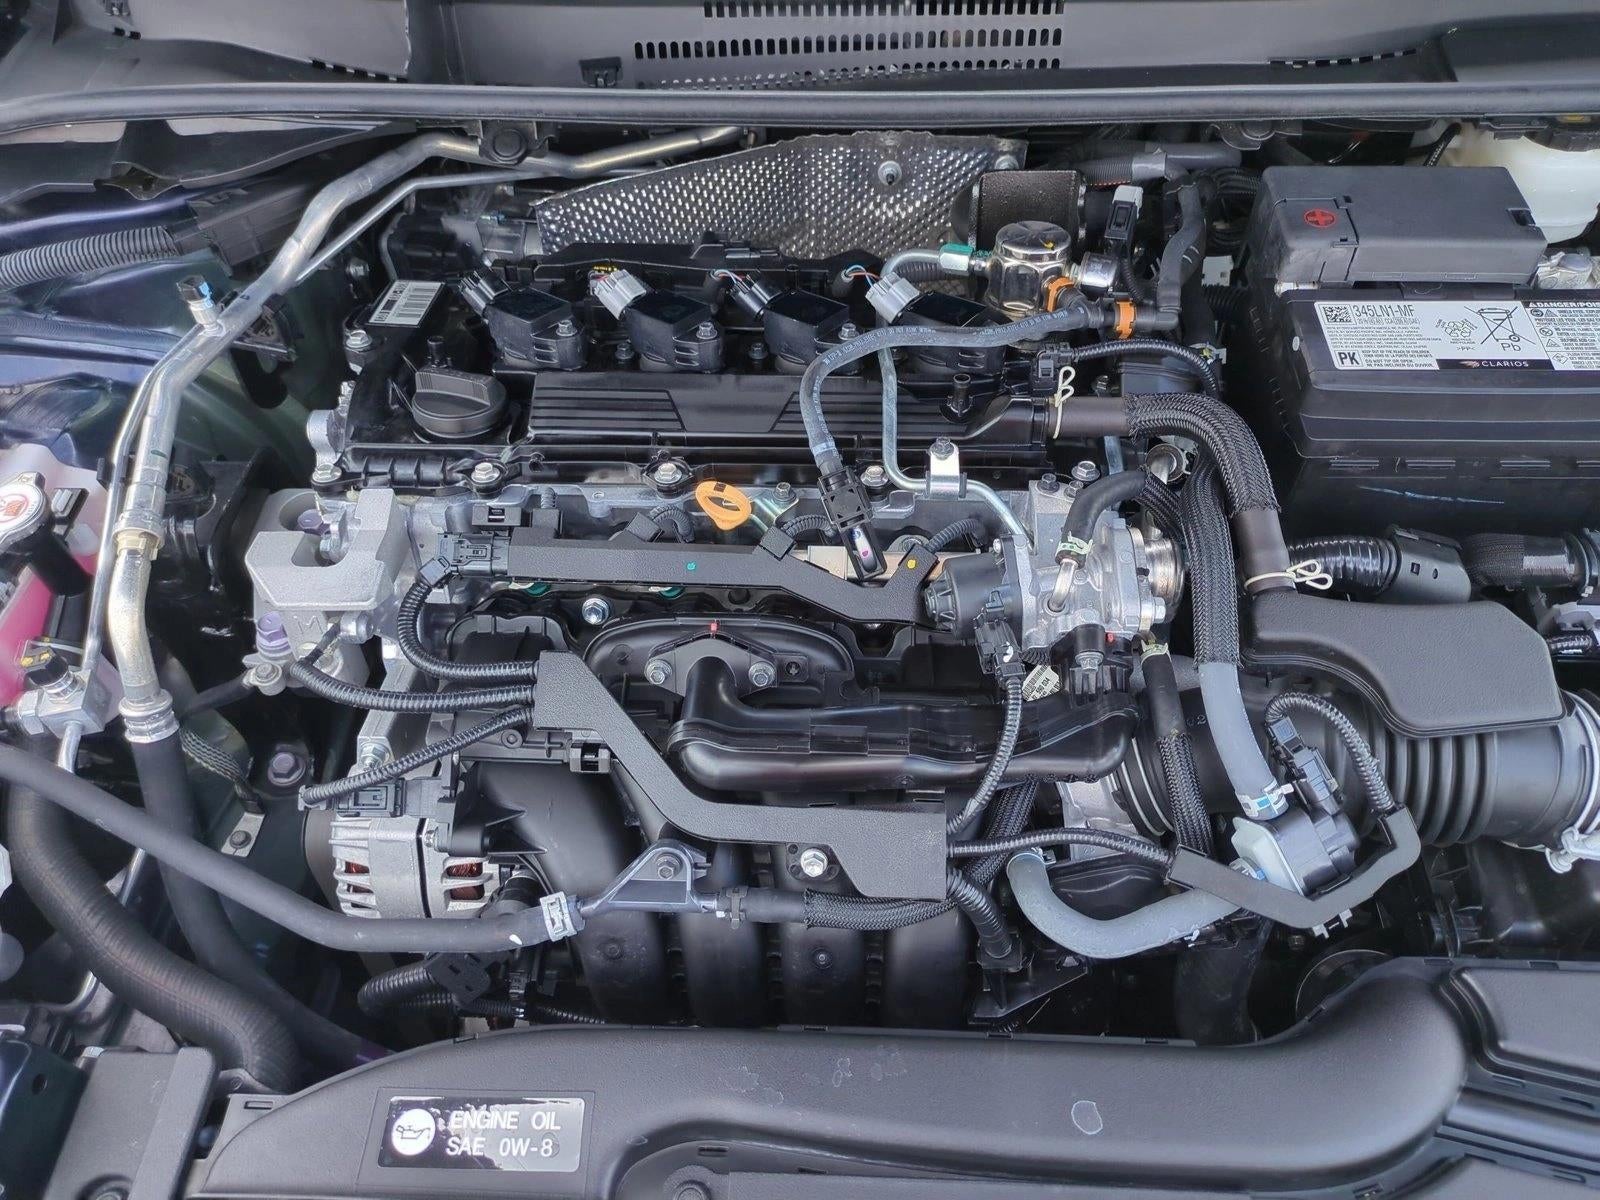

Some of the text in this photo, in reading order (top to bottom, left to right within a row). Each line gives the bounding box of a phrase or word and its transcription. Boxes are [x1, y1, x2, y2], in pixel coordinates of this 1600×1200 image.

[1353, 304, 1415, 317] 345LN1-MF
[1501, 343, 1521, 352] Pb
[1338, 352, 1360, 365] PK
[449, 1111, 561, 1130] ENGINE OIL
[446, 1137, 553, 1156] SAE 0W-8
